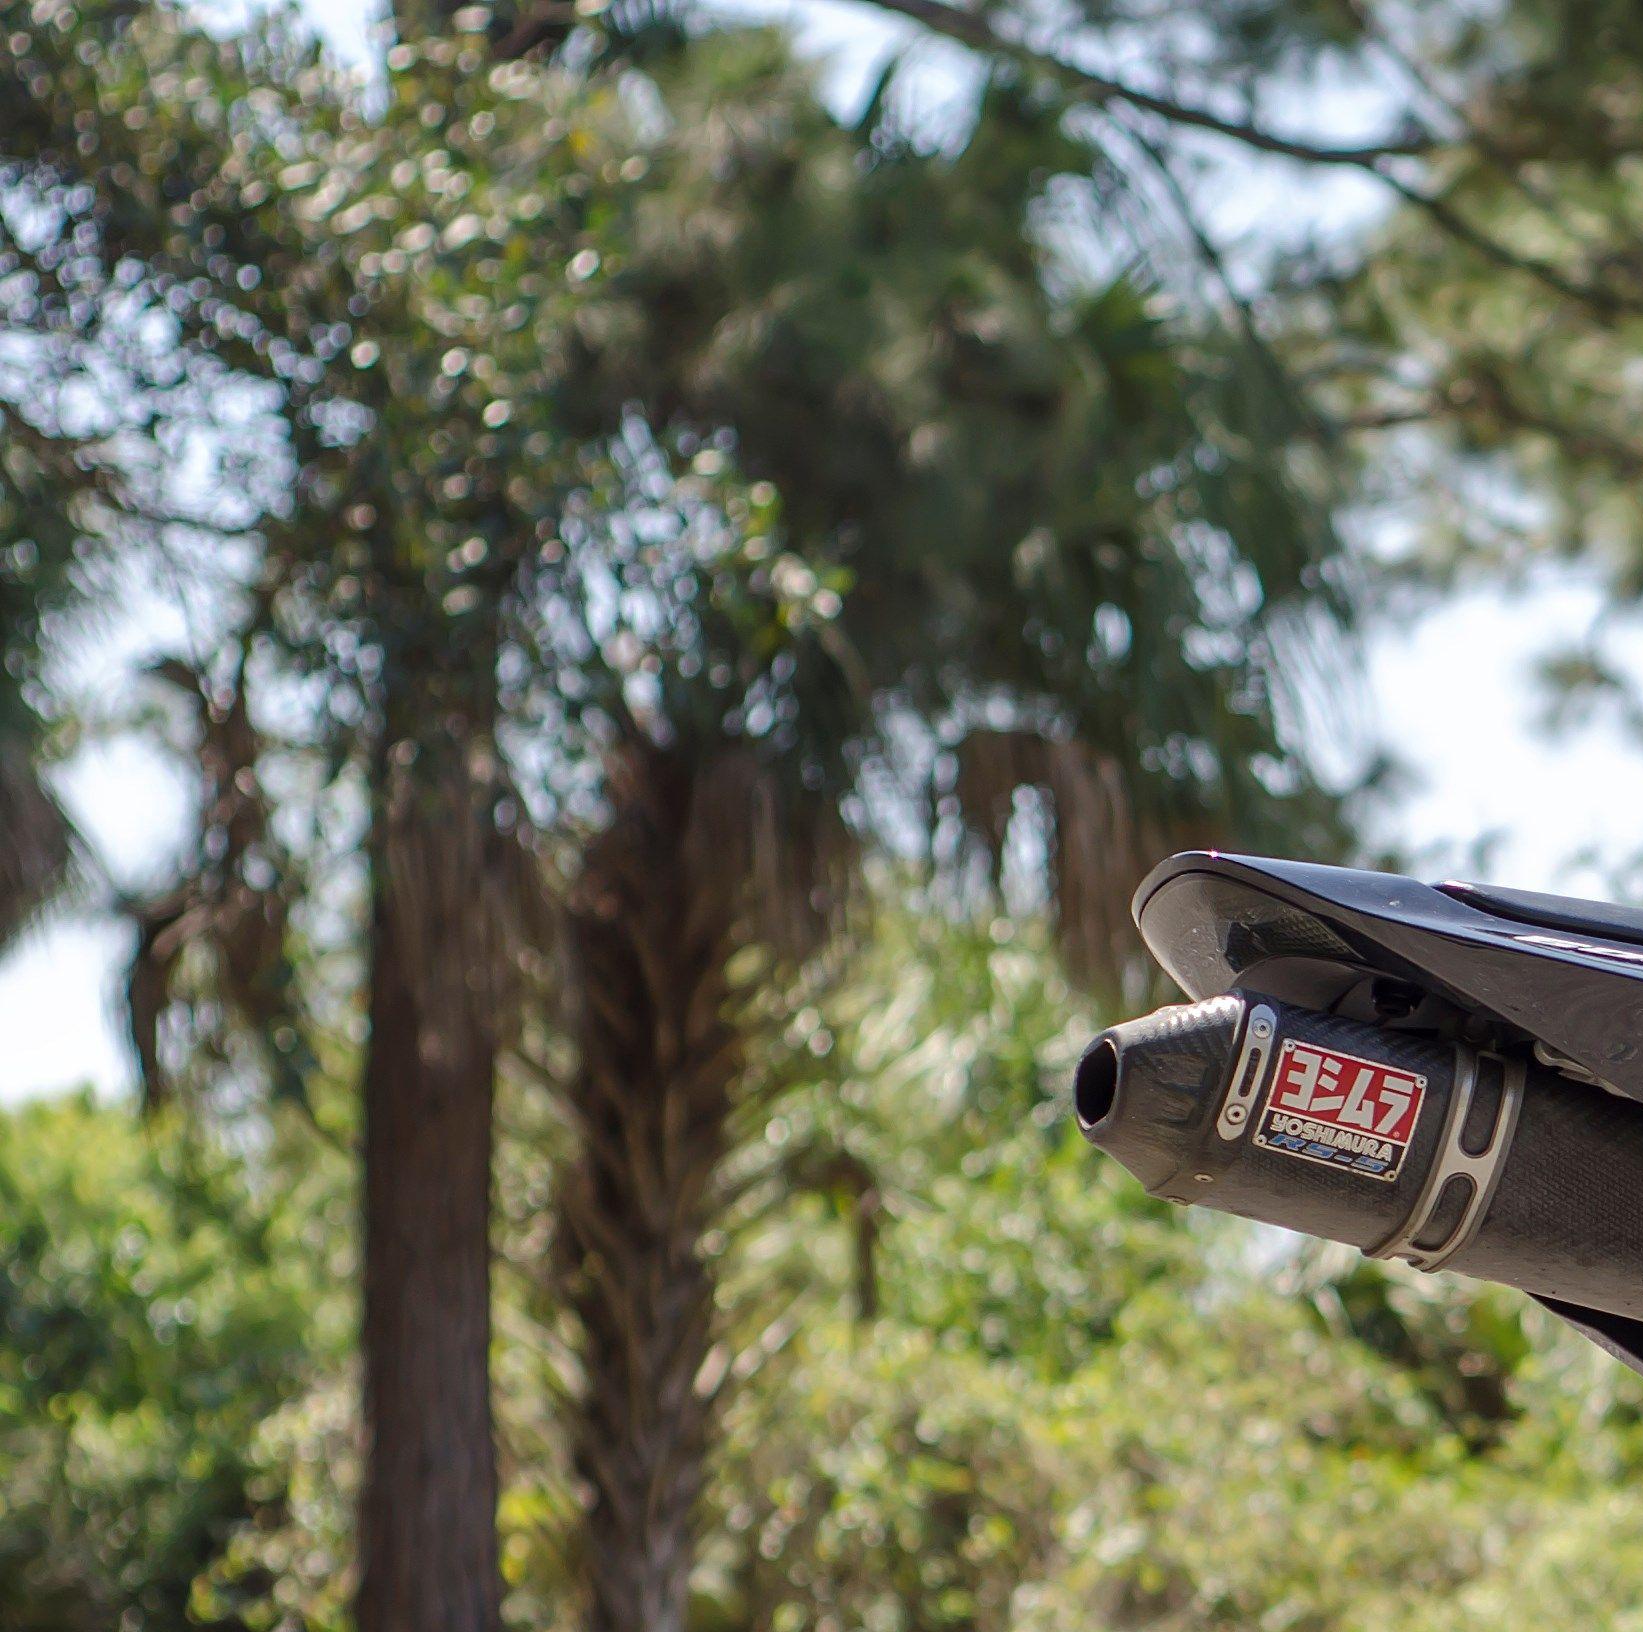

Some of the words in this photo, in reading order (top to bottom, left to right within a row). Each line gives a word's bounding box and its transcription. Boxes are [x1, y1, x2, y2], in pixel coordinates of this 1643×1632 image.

[1280, 1050, 1415, 1135] ヨシムラ
[1270, 1113, 1394, 1162] YOSHIMURA
